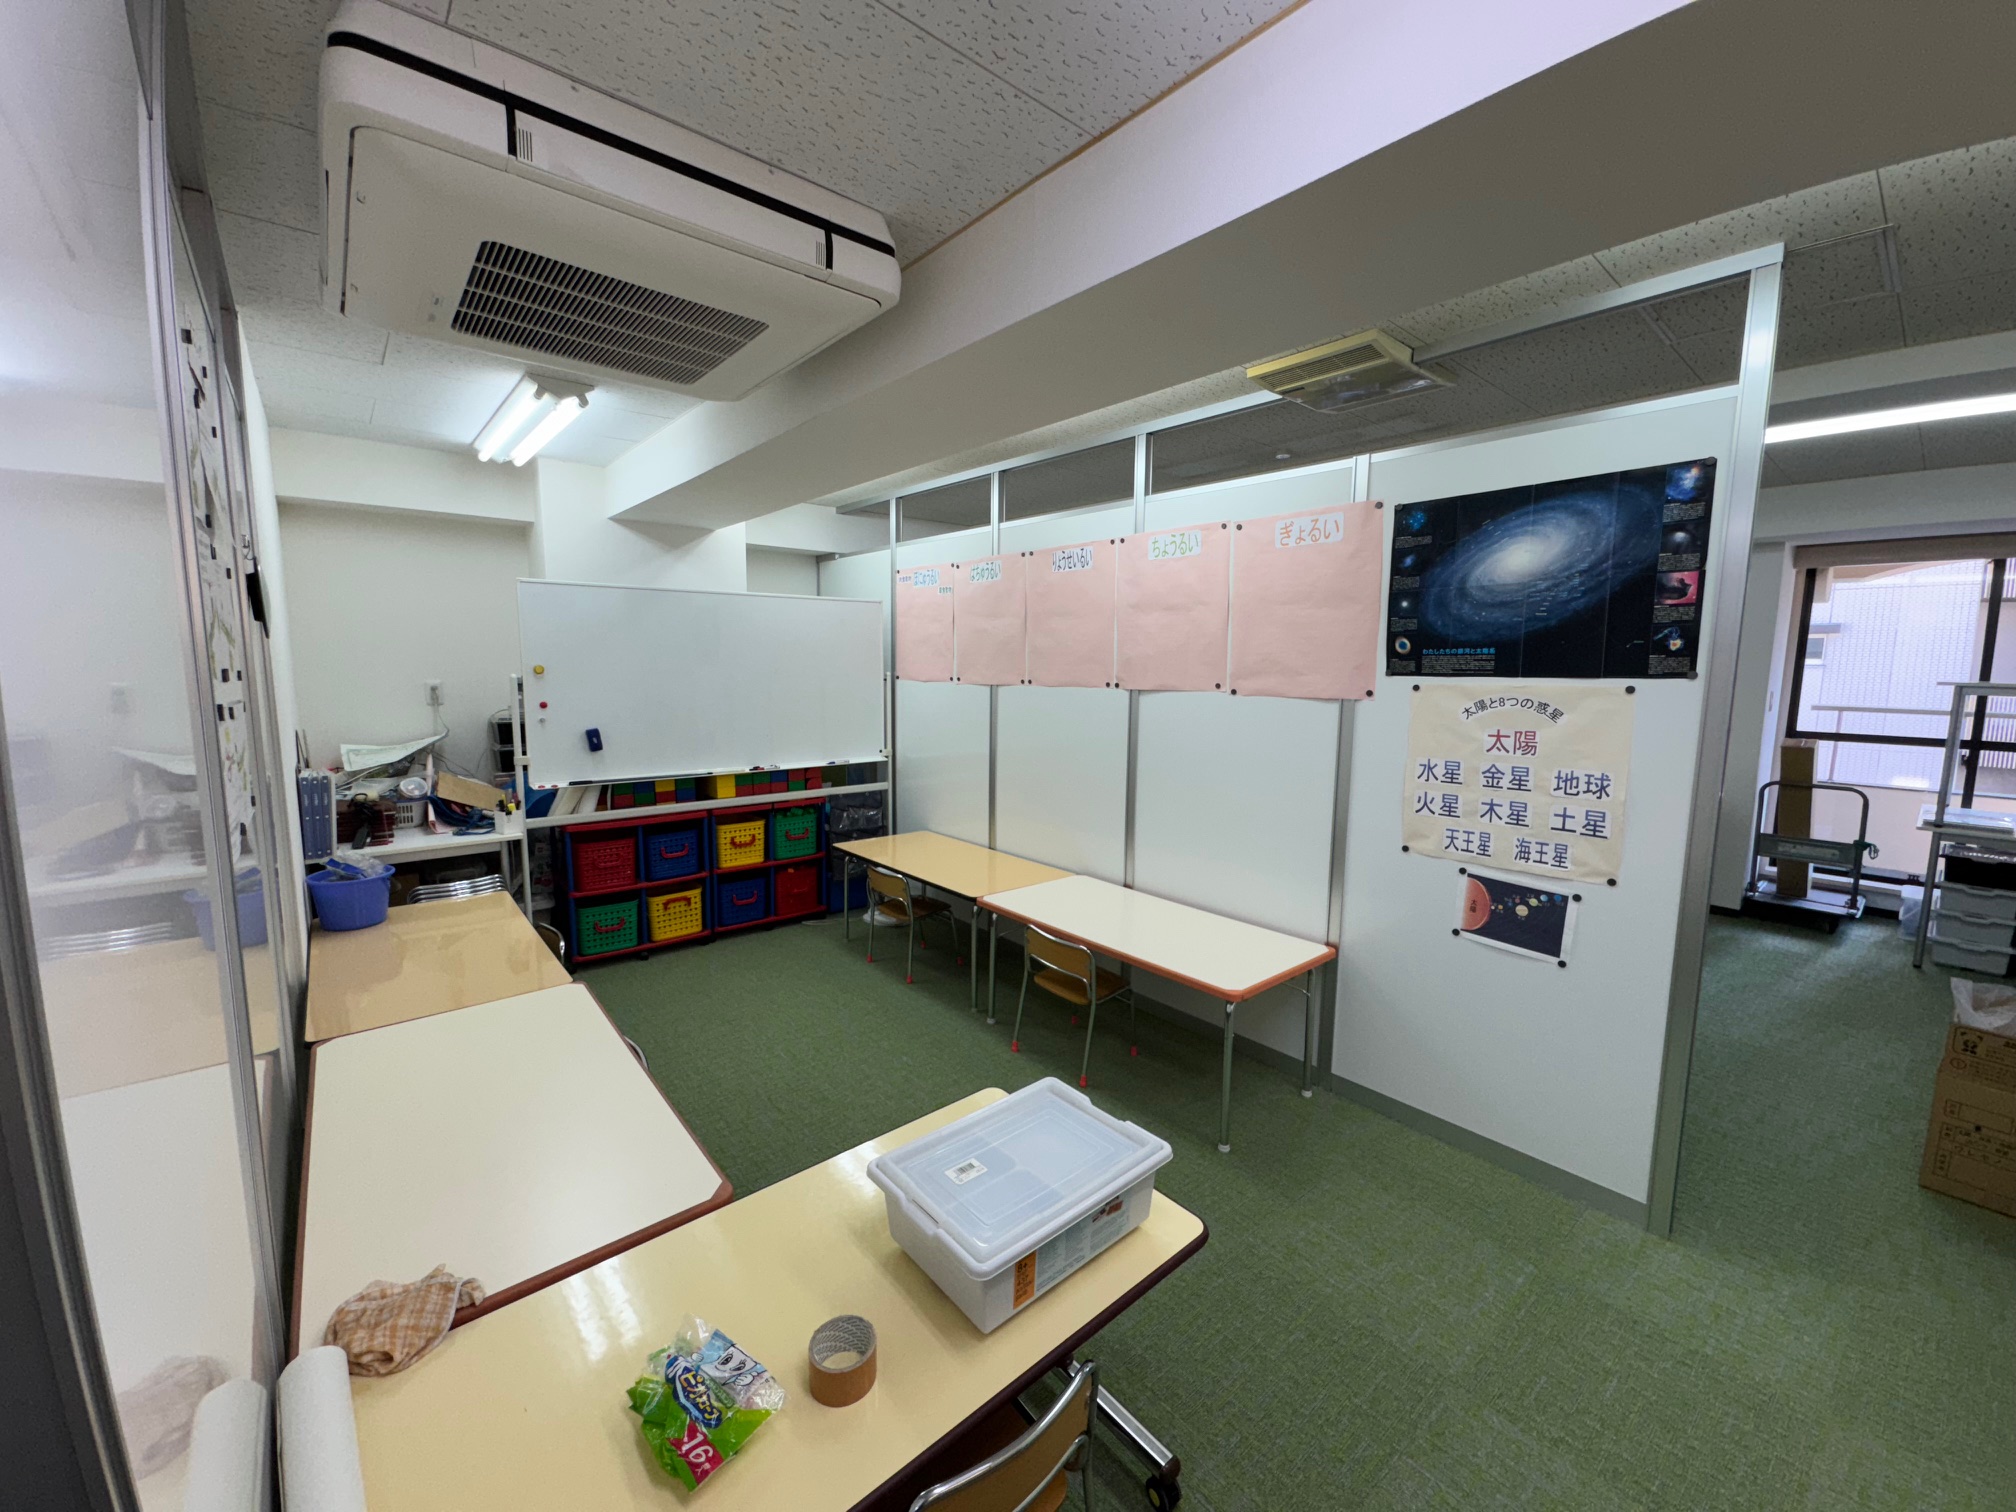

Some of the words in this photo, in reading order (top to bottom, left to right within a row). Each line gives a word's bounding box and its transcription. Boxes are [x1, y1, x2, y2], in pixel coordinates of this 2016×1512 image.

[1152, 532, 1199, 558] ちょうるい
[1280, 517, 1340, 546] ぎょるい
[971, 562, 1001, 582] はちゅうるい
[1052, 547, 1092, 571] りょうせいるい
[1461, 697, 1565, 723] 太陽と8つの惑星
[1486, 729, 1539, 756] 太陽
[1417, 758, 1463, 785] 水星
[1481, 764, 1532, 792] 金星
[1553, 770, 1612, 799] 地球
[1415, 791, 1461, 818] 火星
[1479, 799, 1530, 828] 木星
[1551, 807, 1608, 839] 土星
[1444, 828, 1491, 857] 天王星
[1514, 837, 1569, 869] 海王星
